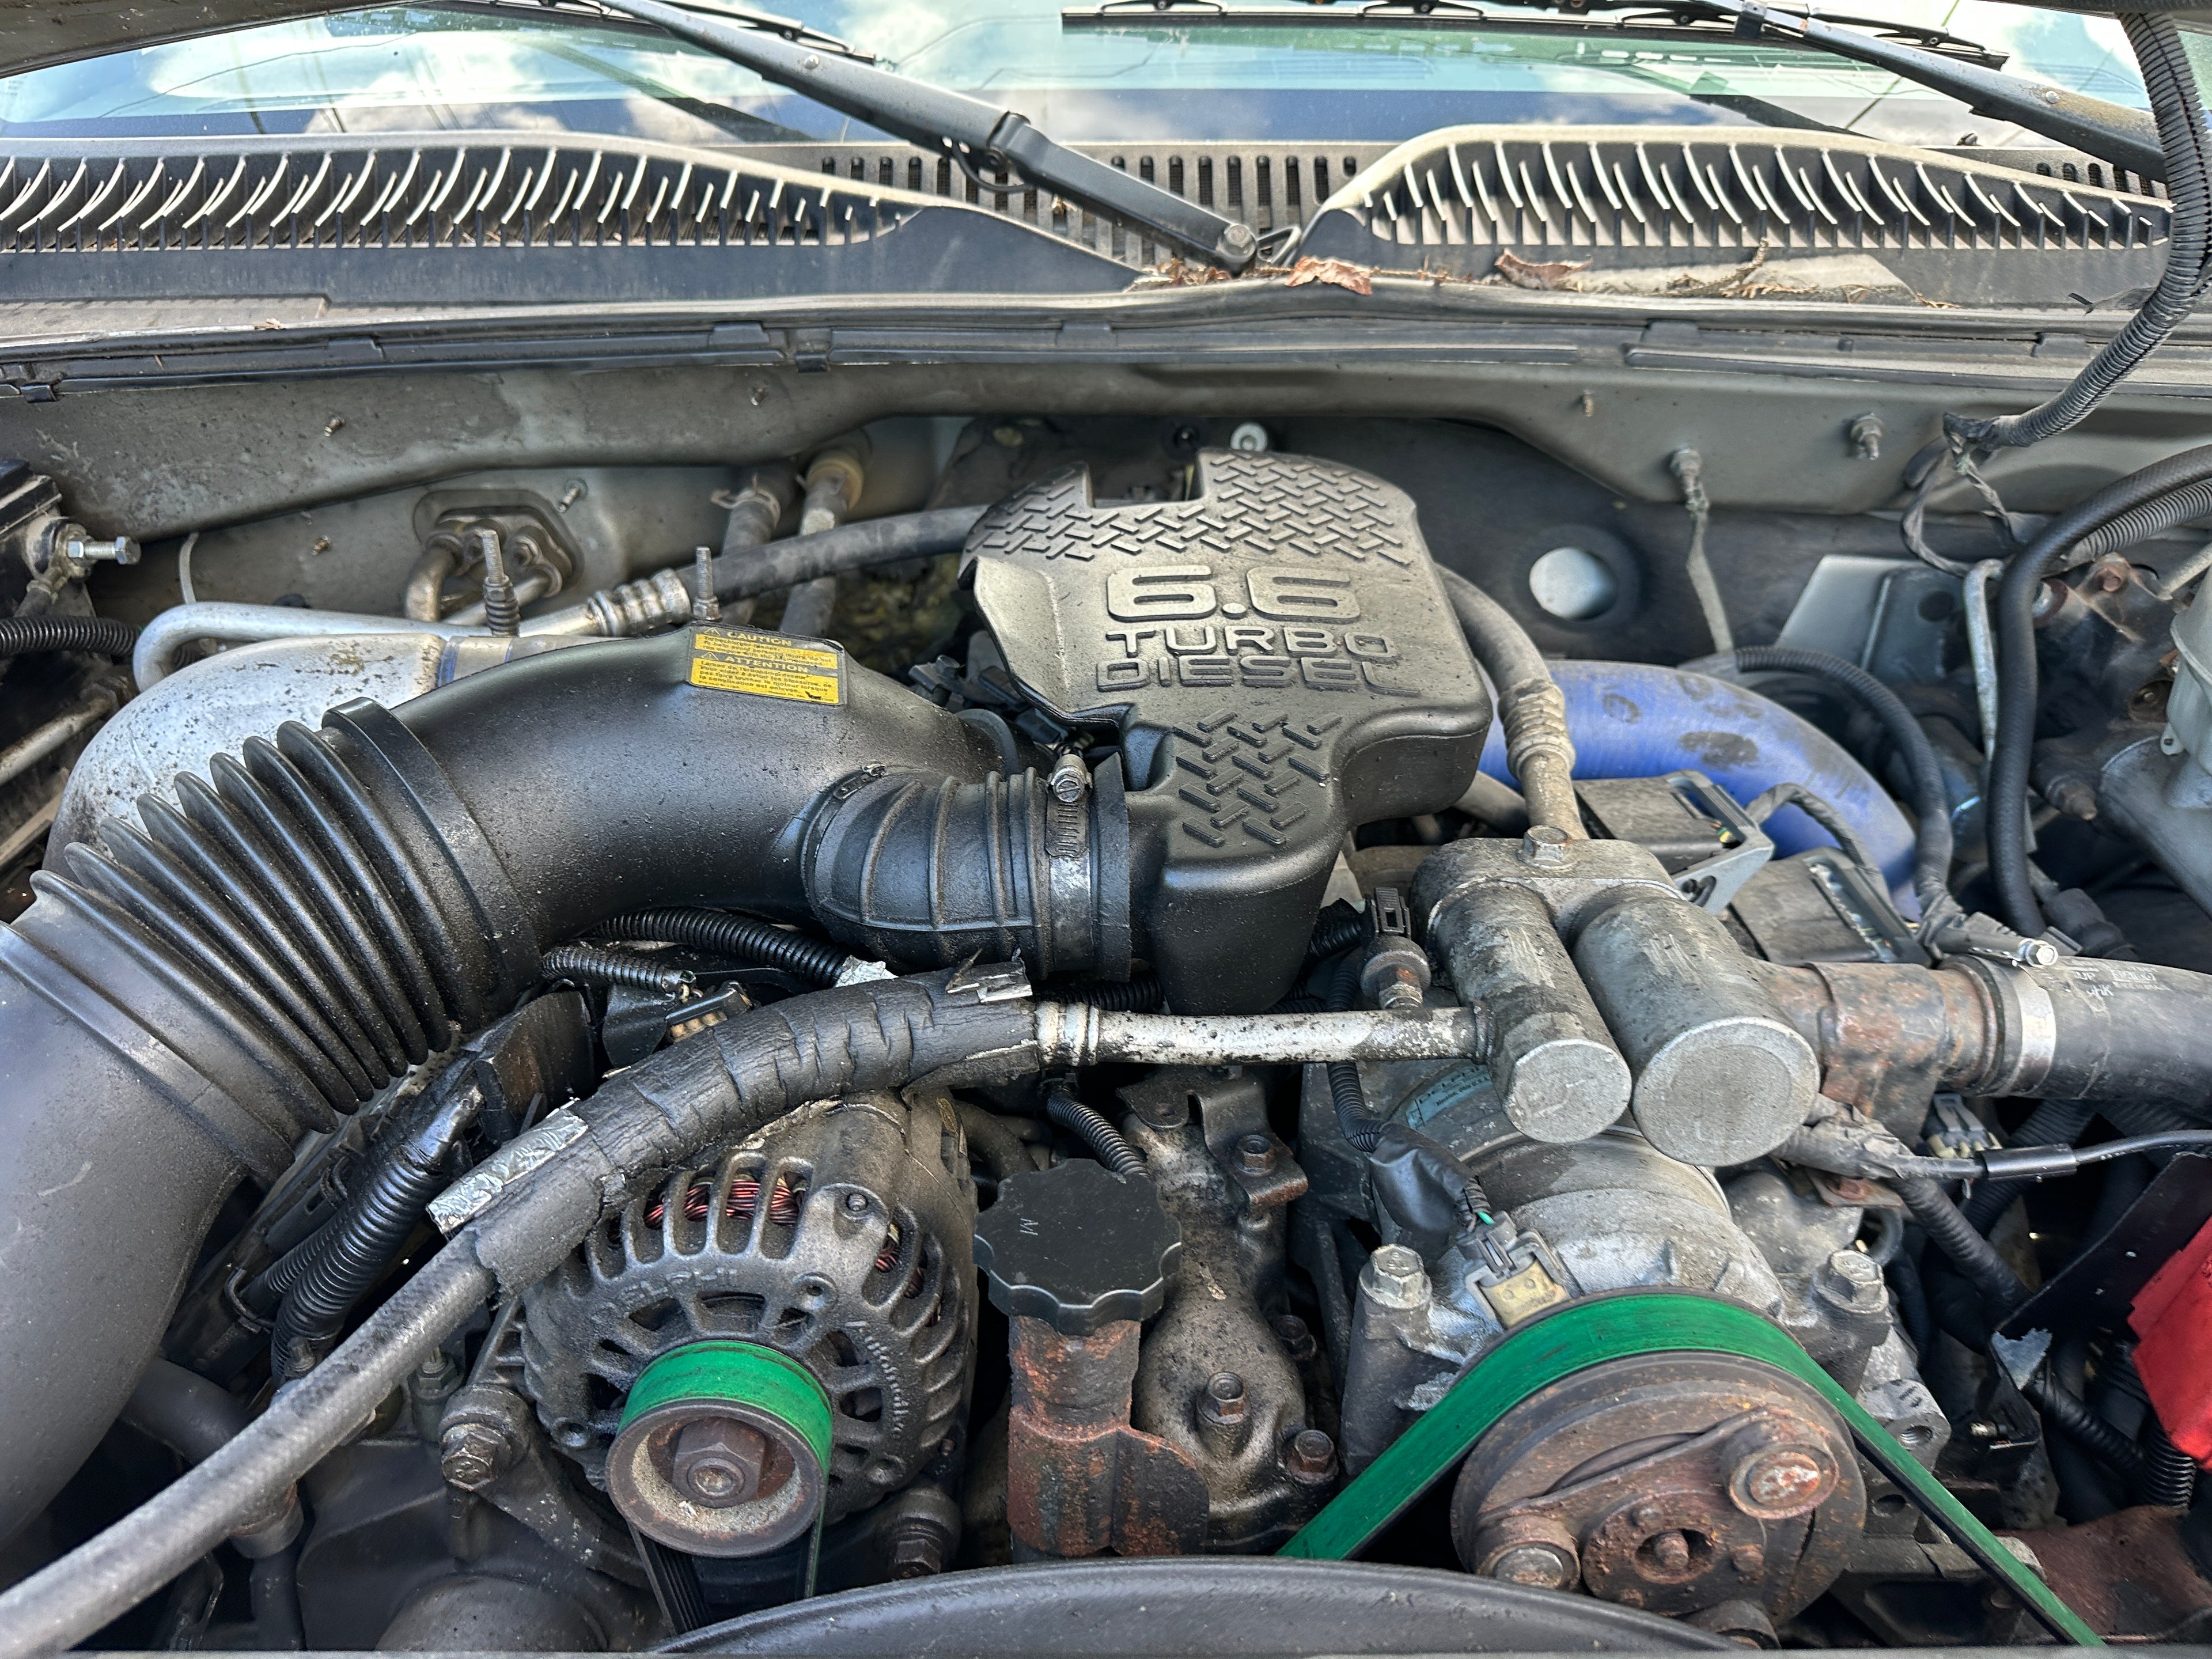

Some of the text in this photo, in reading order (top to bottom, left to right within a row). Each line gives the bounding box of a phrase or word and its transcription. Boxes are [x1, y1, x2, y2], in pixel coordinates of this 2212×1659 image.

[1105, 565, 1361, 623] 6.6
[726, 631, 791, 646] CAUTION
[1105, 625, 1399, 658] TURBO
[724, 655, 808, 673] ATTENTION
[1097, 656, 1420, 695] DIESEL
